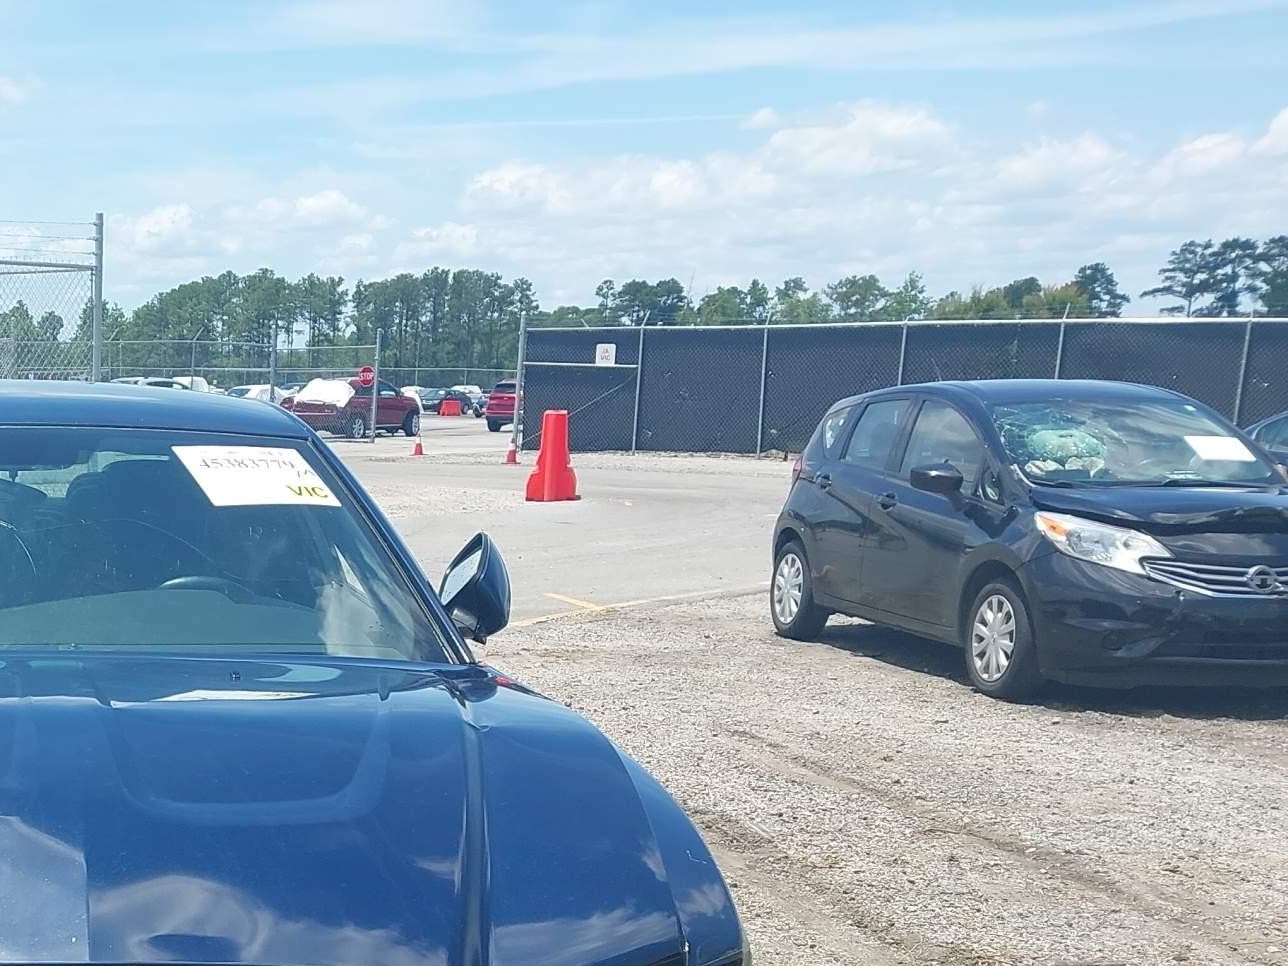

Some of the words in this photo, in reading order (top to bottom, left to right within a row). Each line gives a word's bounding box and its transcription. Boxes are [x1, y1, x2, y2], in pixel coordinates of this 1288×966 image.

[360, 371, 374, 381] STOP
[199, 457, 296, 471] 45383779
[285, 484, 329, 499] VIC
